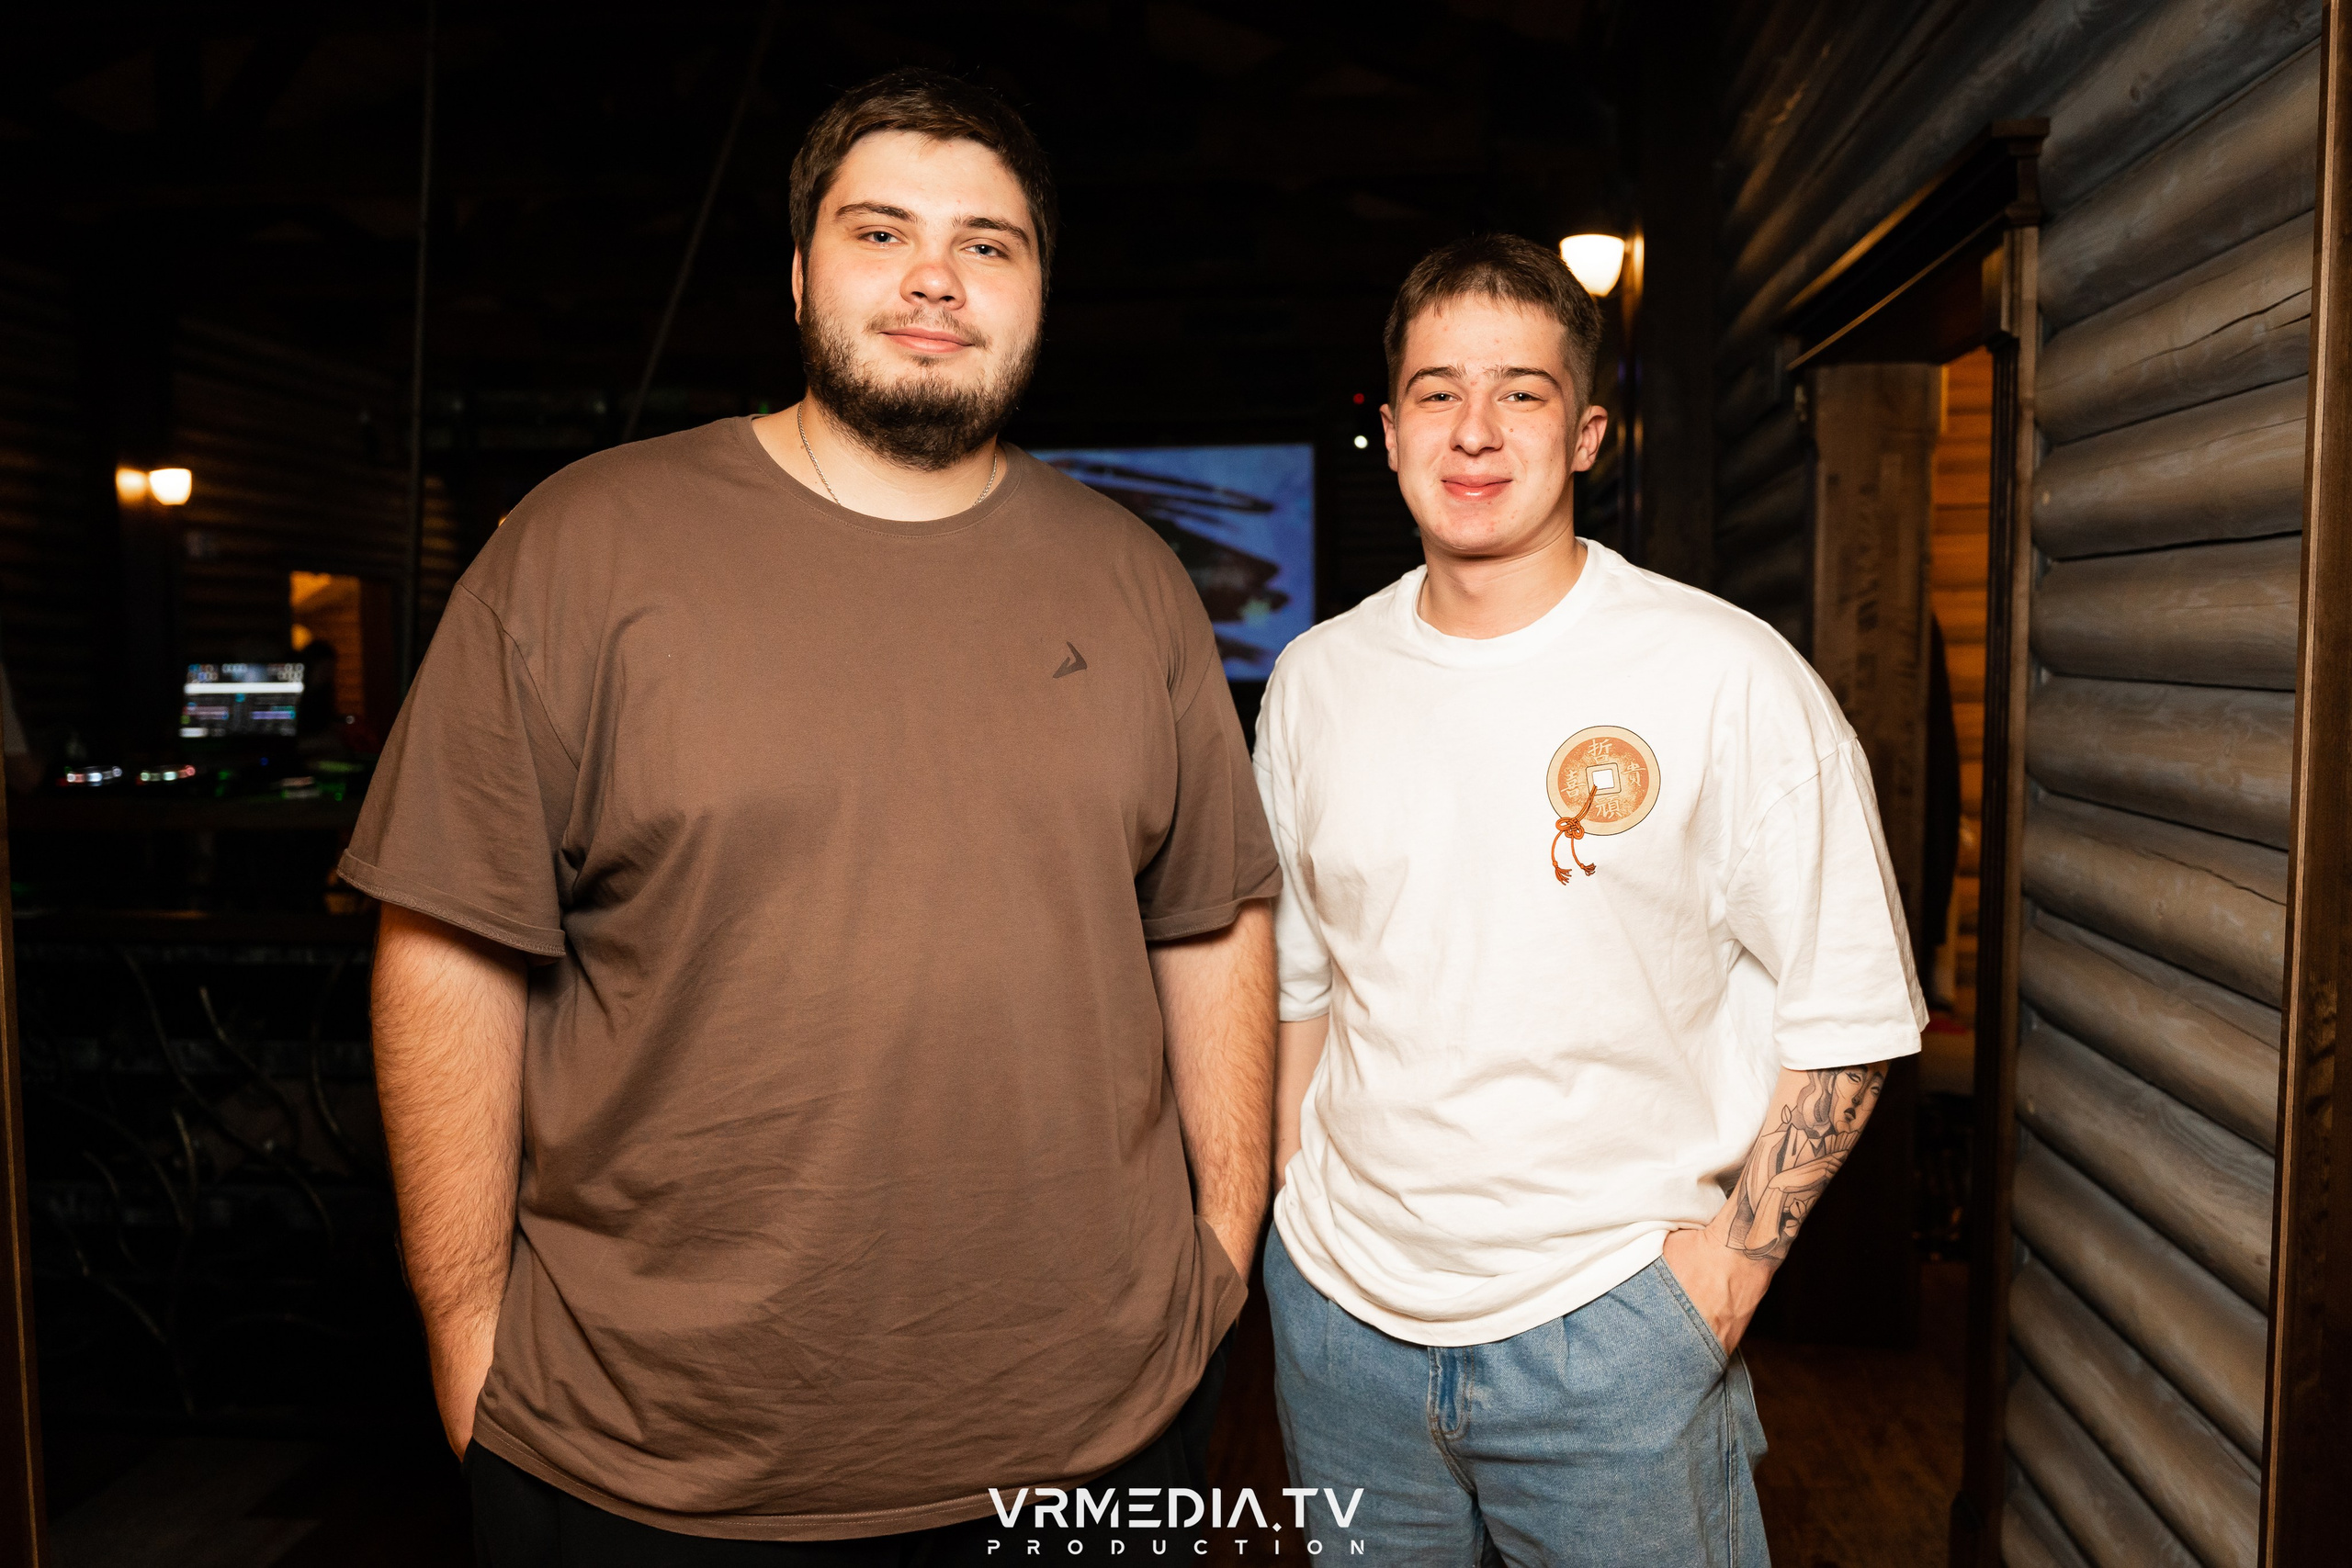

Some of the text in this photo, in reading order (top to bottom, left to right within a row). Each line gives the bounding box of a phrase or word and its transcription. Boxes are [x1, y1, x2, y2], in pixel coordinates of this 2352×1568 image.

[1588, 739, 1613, 764] 哲
[1560, 770, 1586, 797] 喜
[1621, 761, 1646, 787] 貴
